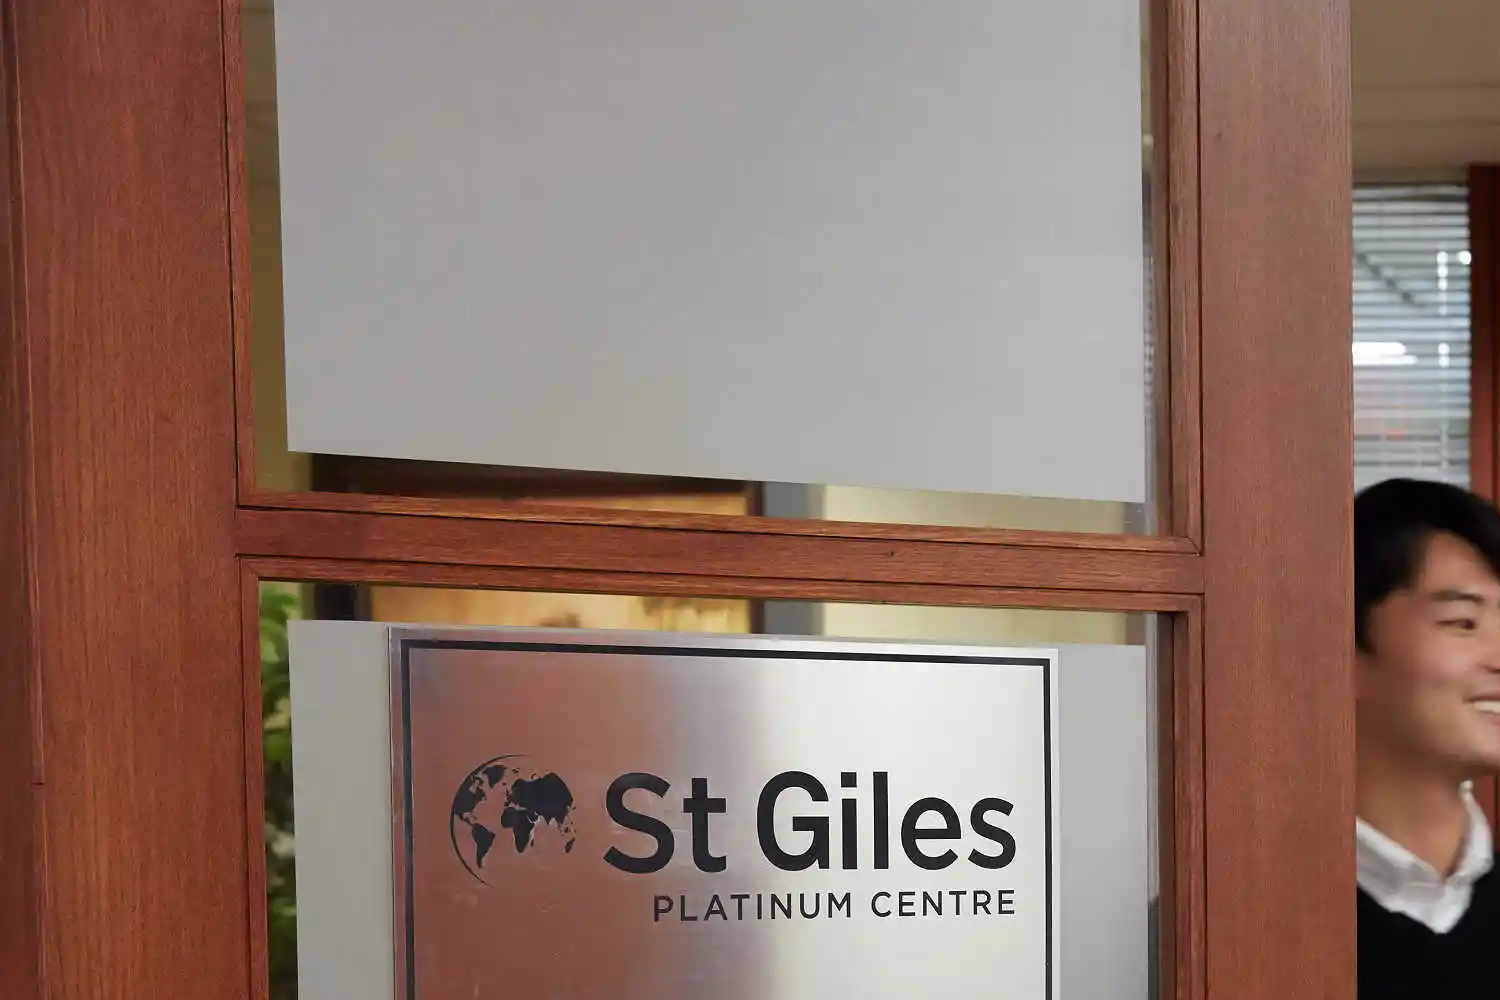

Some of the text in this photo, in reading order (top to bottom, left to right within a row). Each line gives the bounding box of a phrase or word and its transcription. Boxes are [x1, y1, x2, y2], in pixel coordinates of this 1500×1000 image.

[602, 770, 1017, 874] St Giles
[652, 889, 1016, 923] PLATINUM CENTRE
